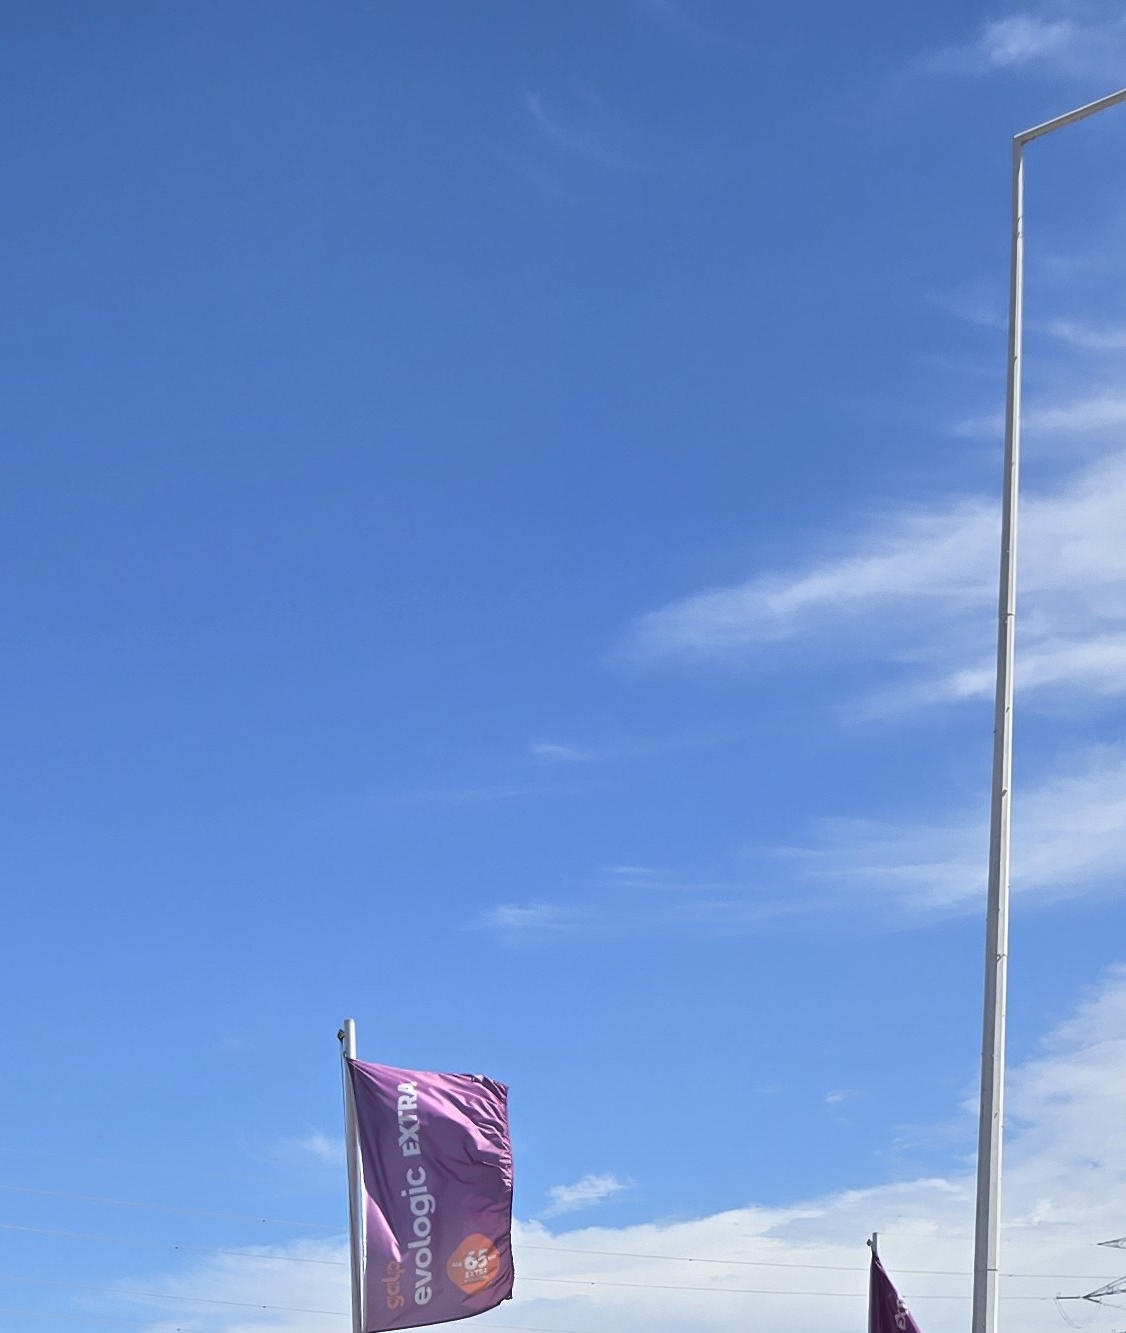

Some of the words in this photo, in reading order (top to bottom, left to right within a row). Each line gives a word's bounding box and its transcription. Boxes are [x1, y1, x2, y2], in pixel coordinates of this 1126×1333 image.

[396, 1081, 422, 1157] EXTRA
[401, 1166, 436, 1306] evologic
[381, 1260, 406, 1311] galp
